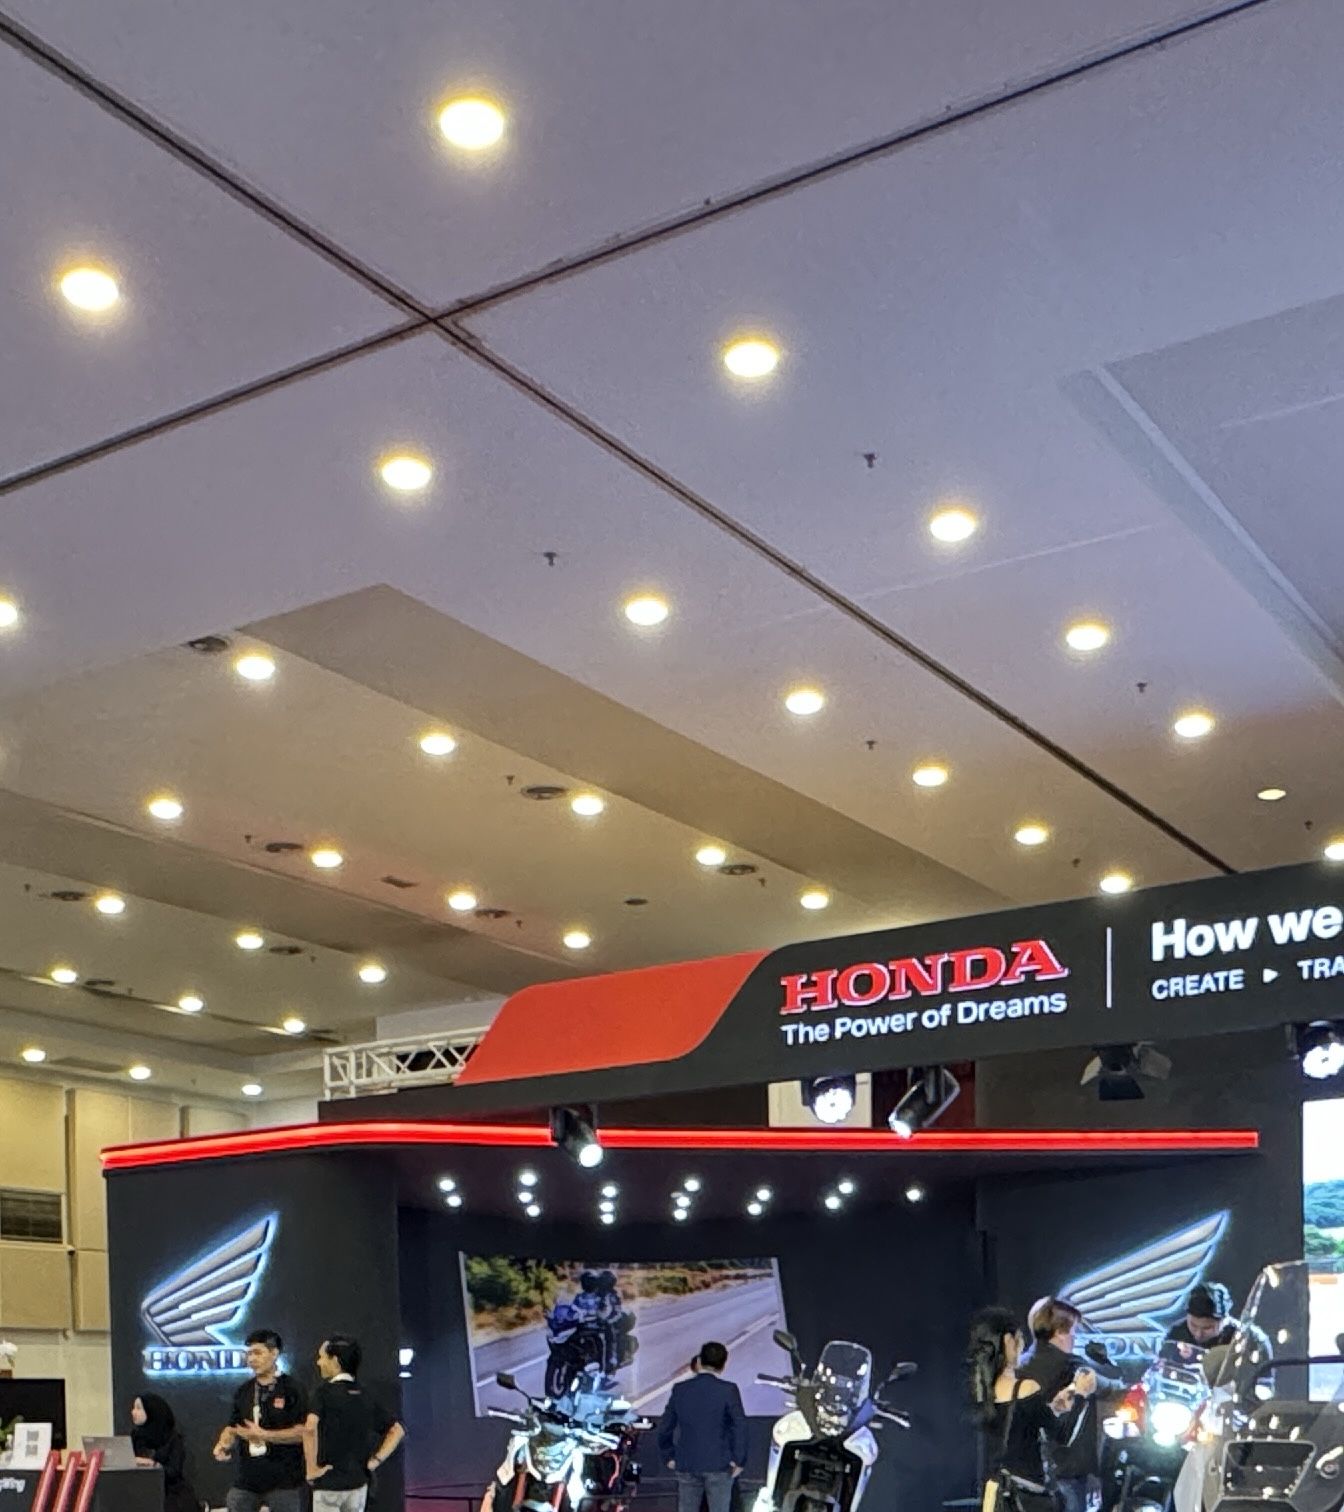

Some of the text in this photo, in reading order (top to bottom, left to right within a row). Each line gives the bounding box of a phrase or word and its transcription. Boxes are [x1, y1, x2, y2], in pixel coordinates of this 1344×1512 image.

[1151, 916, 1259, 962] How
[1268, 906, 1343, 944] we
[779, 940, 1070, 1015] HONDA
[1151, 968, 1245, 1001] CREATE
[780, 992, 1068, 1046] The Power of Dreams
[142, 1347, 288, 1375] HOND
